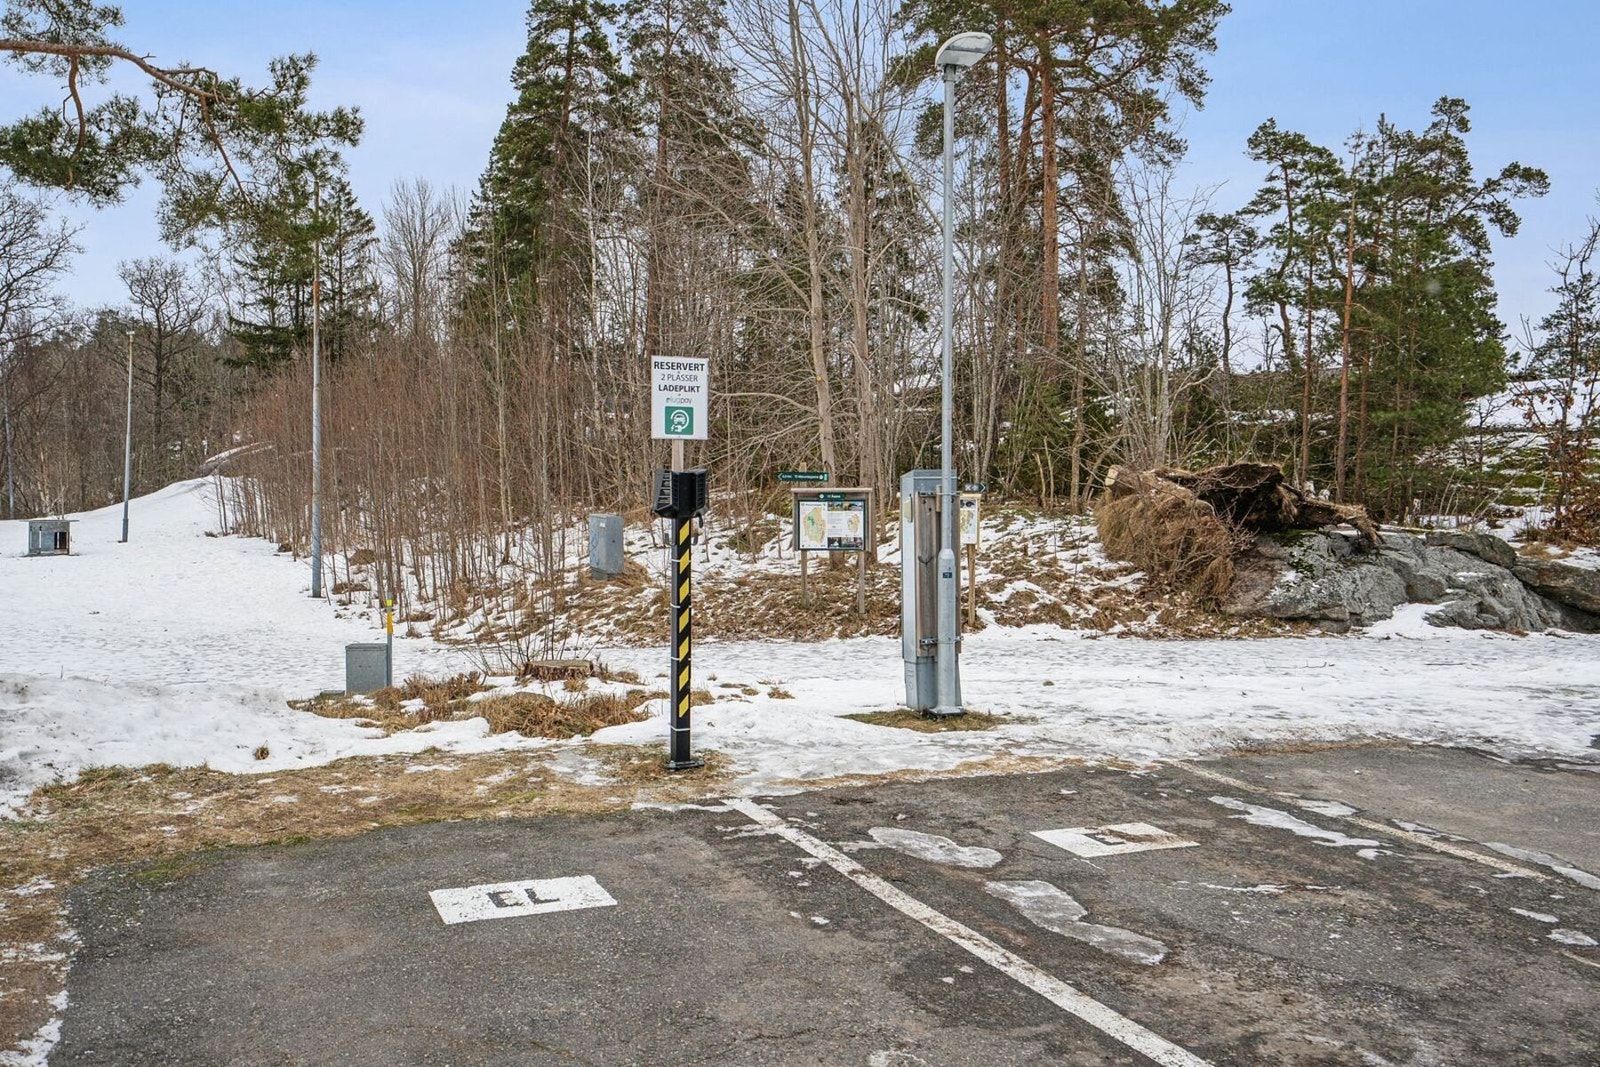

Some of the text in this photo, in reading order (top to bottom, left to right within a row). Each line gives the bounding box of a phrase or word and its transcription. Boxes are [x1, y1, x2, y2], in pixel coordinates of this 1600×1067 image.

[653, 361, 705, 372] RESERVERT
[658, 384, 701, 393] LADEPLIKT
[486, 888, 560, 908] EL
